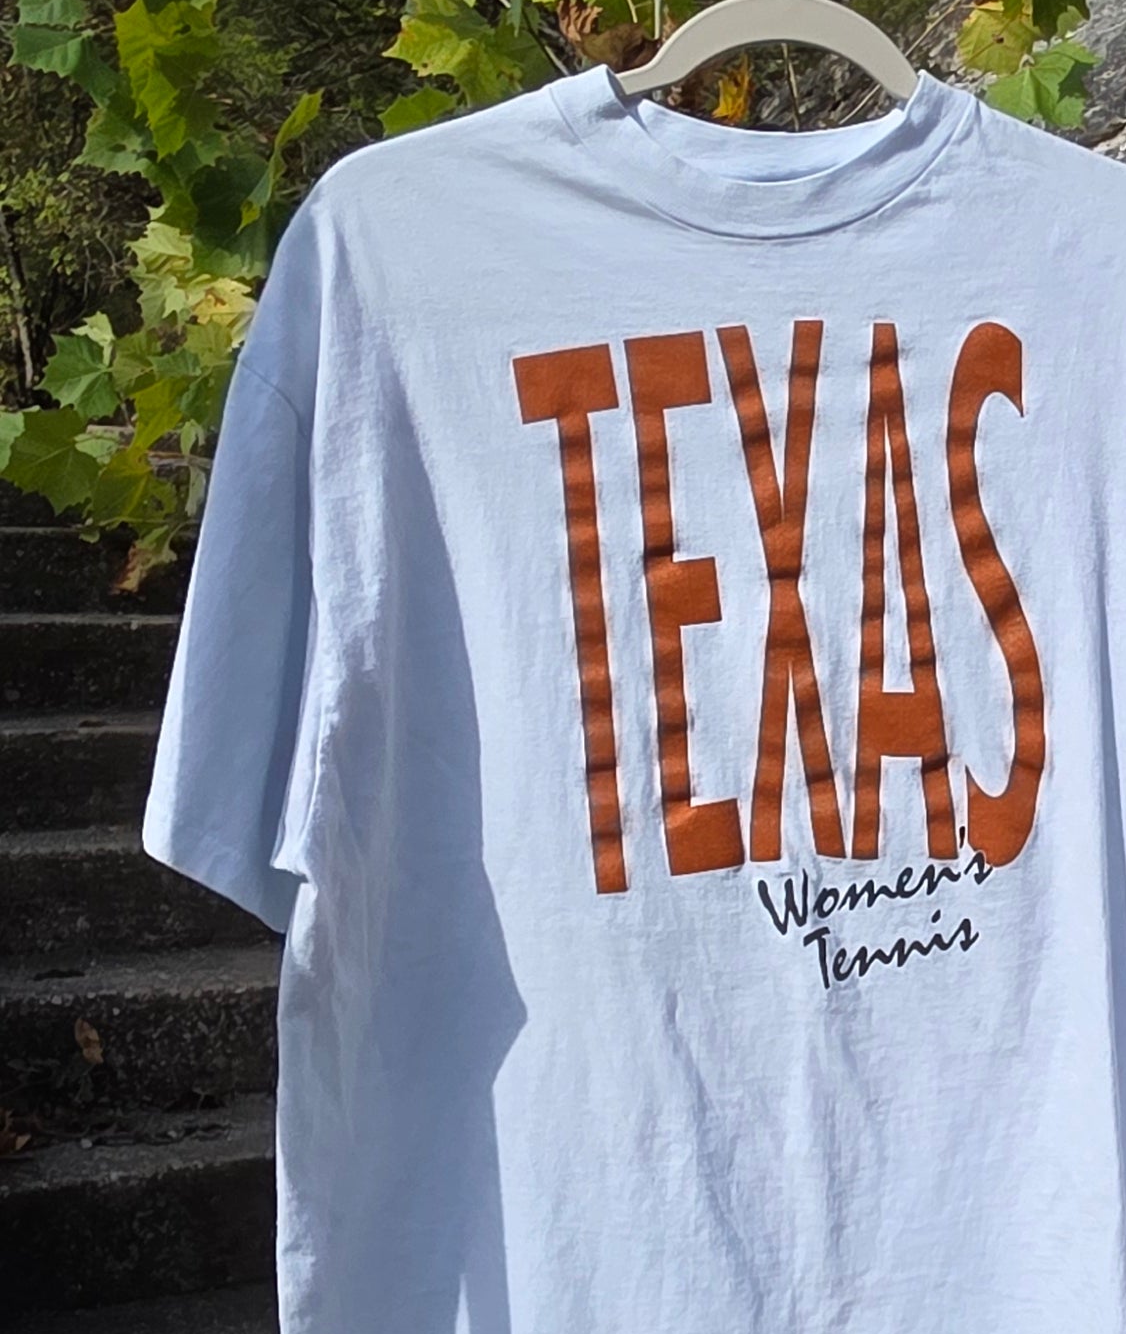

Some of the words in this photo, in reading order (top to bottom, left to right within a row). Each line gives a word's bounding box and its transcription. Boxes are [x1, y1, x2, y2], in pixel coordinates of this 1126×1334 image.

[513, 320, 1044, 893] TEXAS
[758, 826, 993, 935] Women's
[803, 909, 979, 989] Tennis
